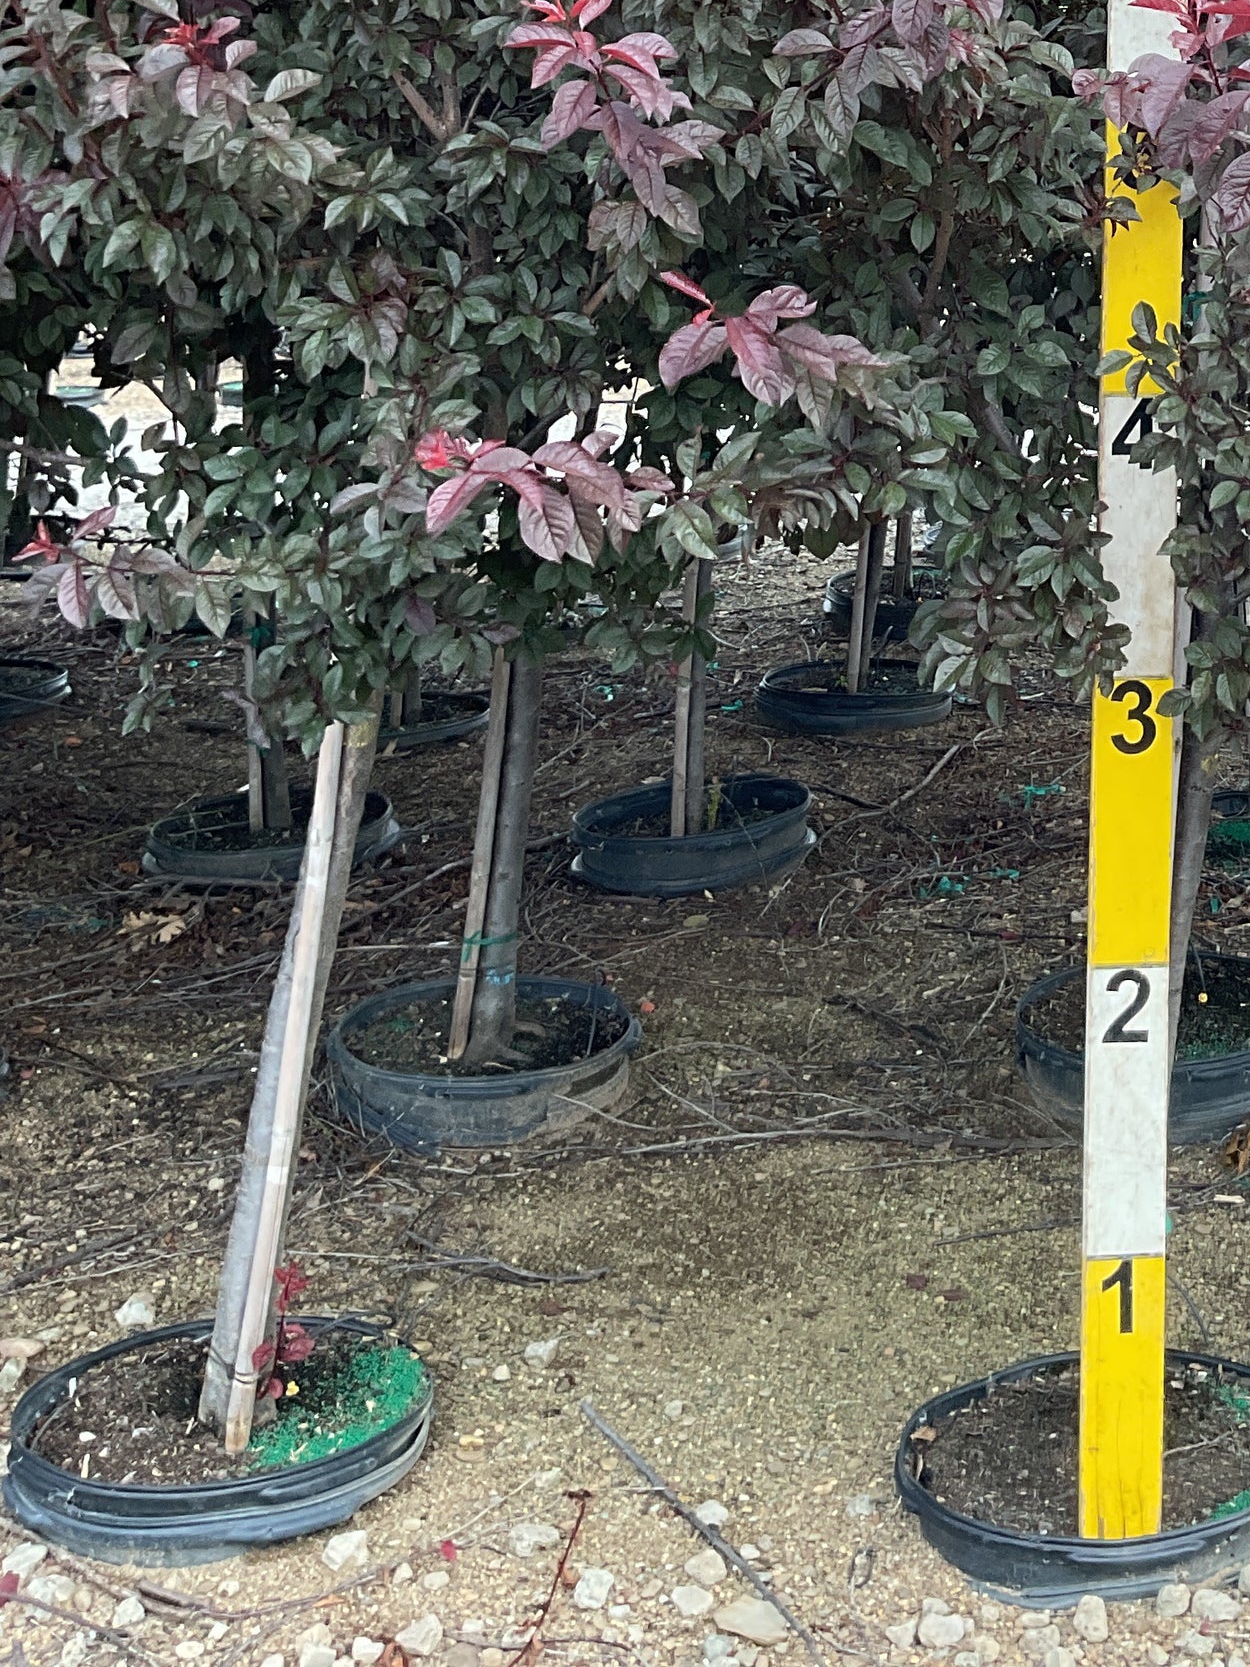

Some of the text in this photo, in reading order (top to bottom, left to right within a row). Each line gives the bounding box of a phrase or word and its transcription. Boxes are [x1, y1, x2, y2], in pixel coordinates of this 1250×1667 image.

[1112, 398, 1154, 469] 4
[1111, 680, 1156, 754] 3
[1102, 969, 1150, 1043] 2
[1102, 1259, 1133, 1333] 1
